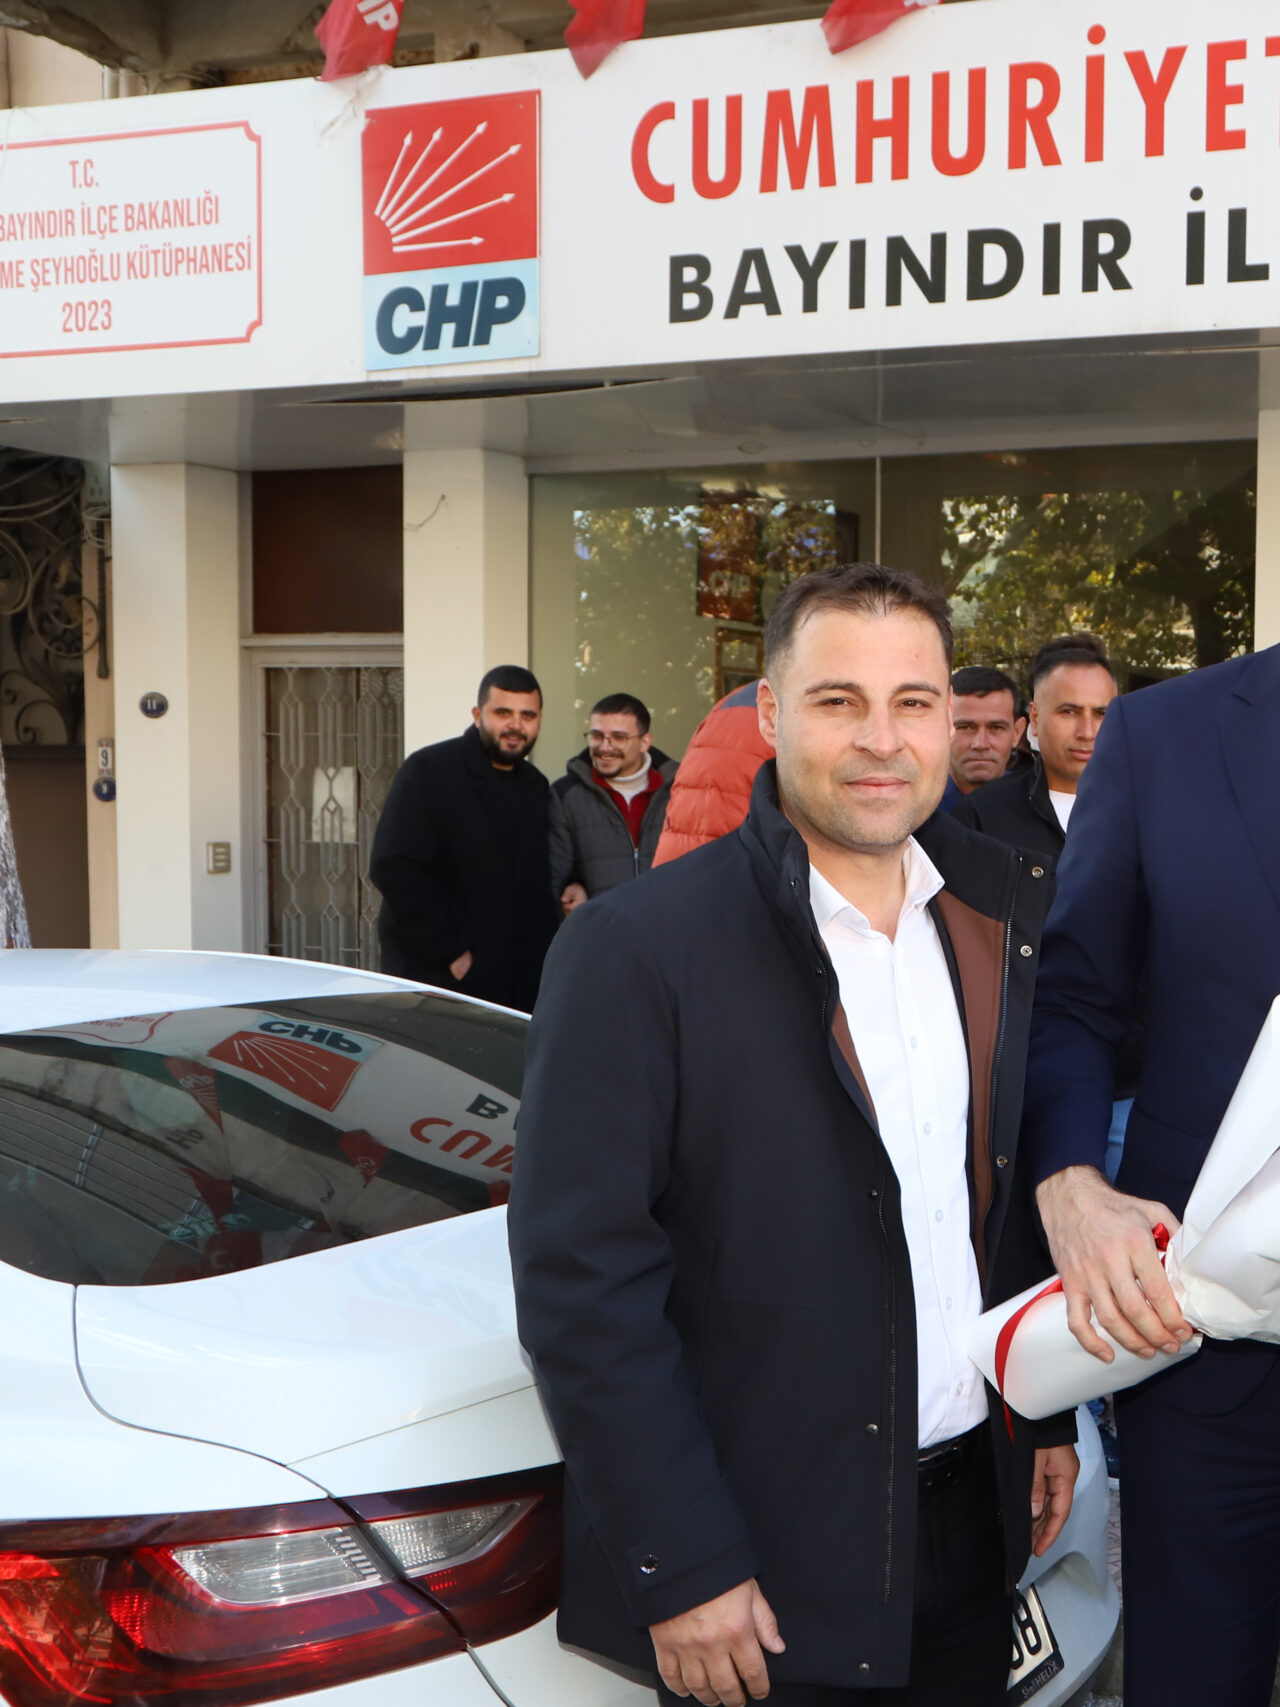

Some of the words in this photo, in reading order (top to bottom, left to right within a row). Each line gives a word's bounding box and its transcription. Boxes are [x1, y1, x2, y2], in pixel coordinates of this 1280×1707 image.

[69, 159, 100, 188] T.C.
[80, 202, 119, 240] İLÇE
[124, 190, 219, 232] BAKANLIĞI
[30, 248, 121, 292] ŞEYHOĞLU
[127, 235, 252, 280] KÜTÜPHANESİ
[670, 219, 1132, 323] BAYINDIR
[62, 299, 112, 333] 2023
[377, 278, 525, 354] CHP
[101, 749, 109, 767] 9
